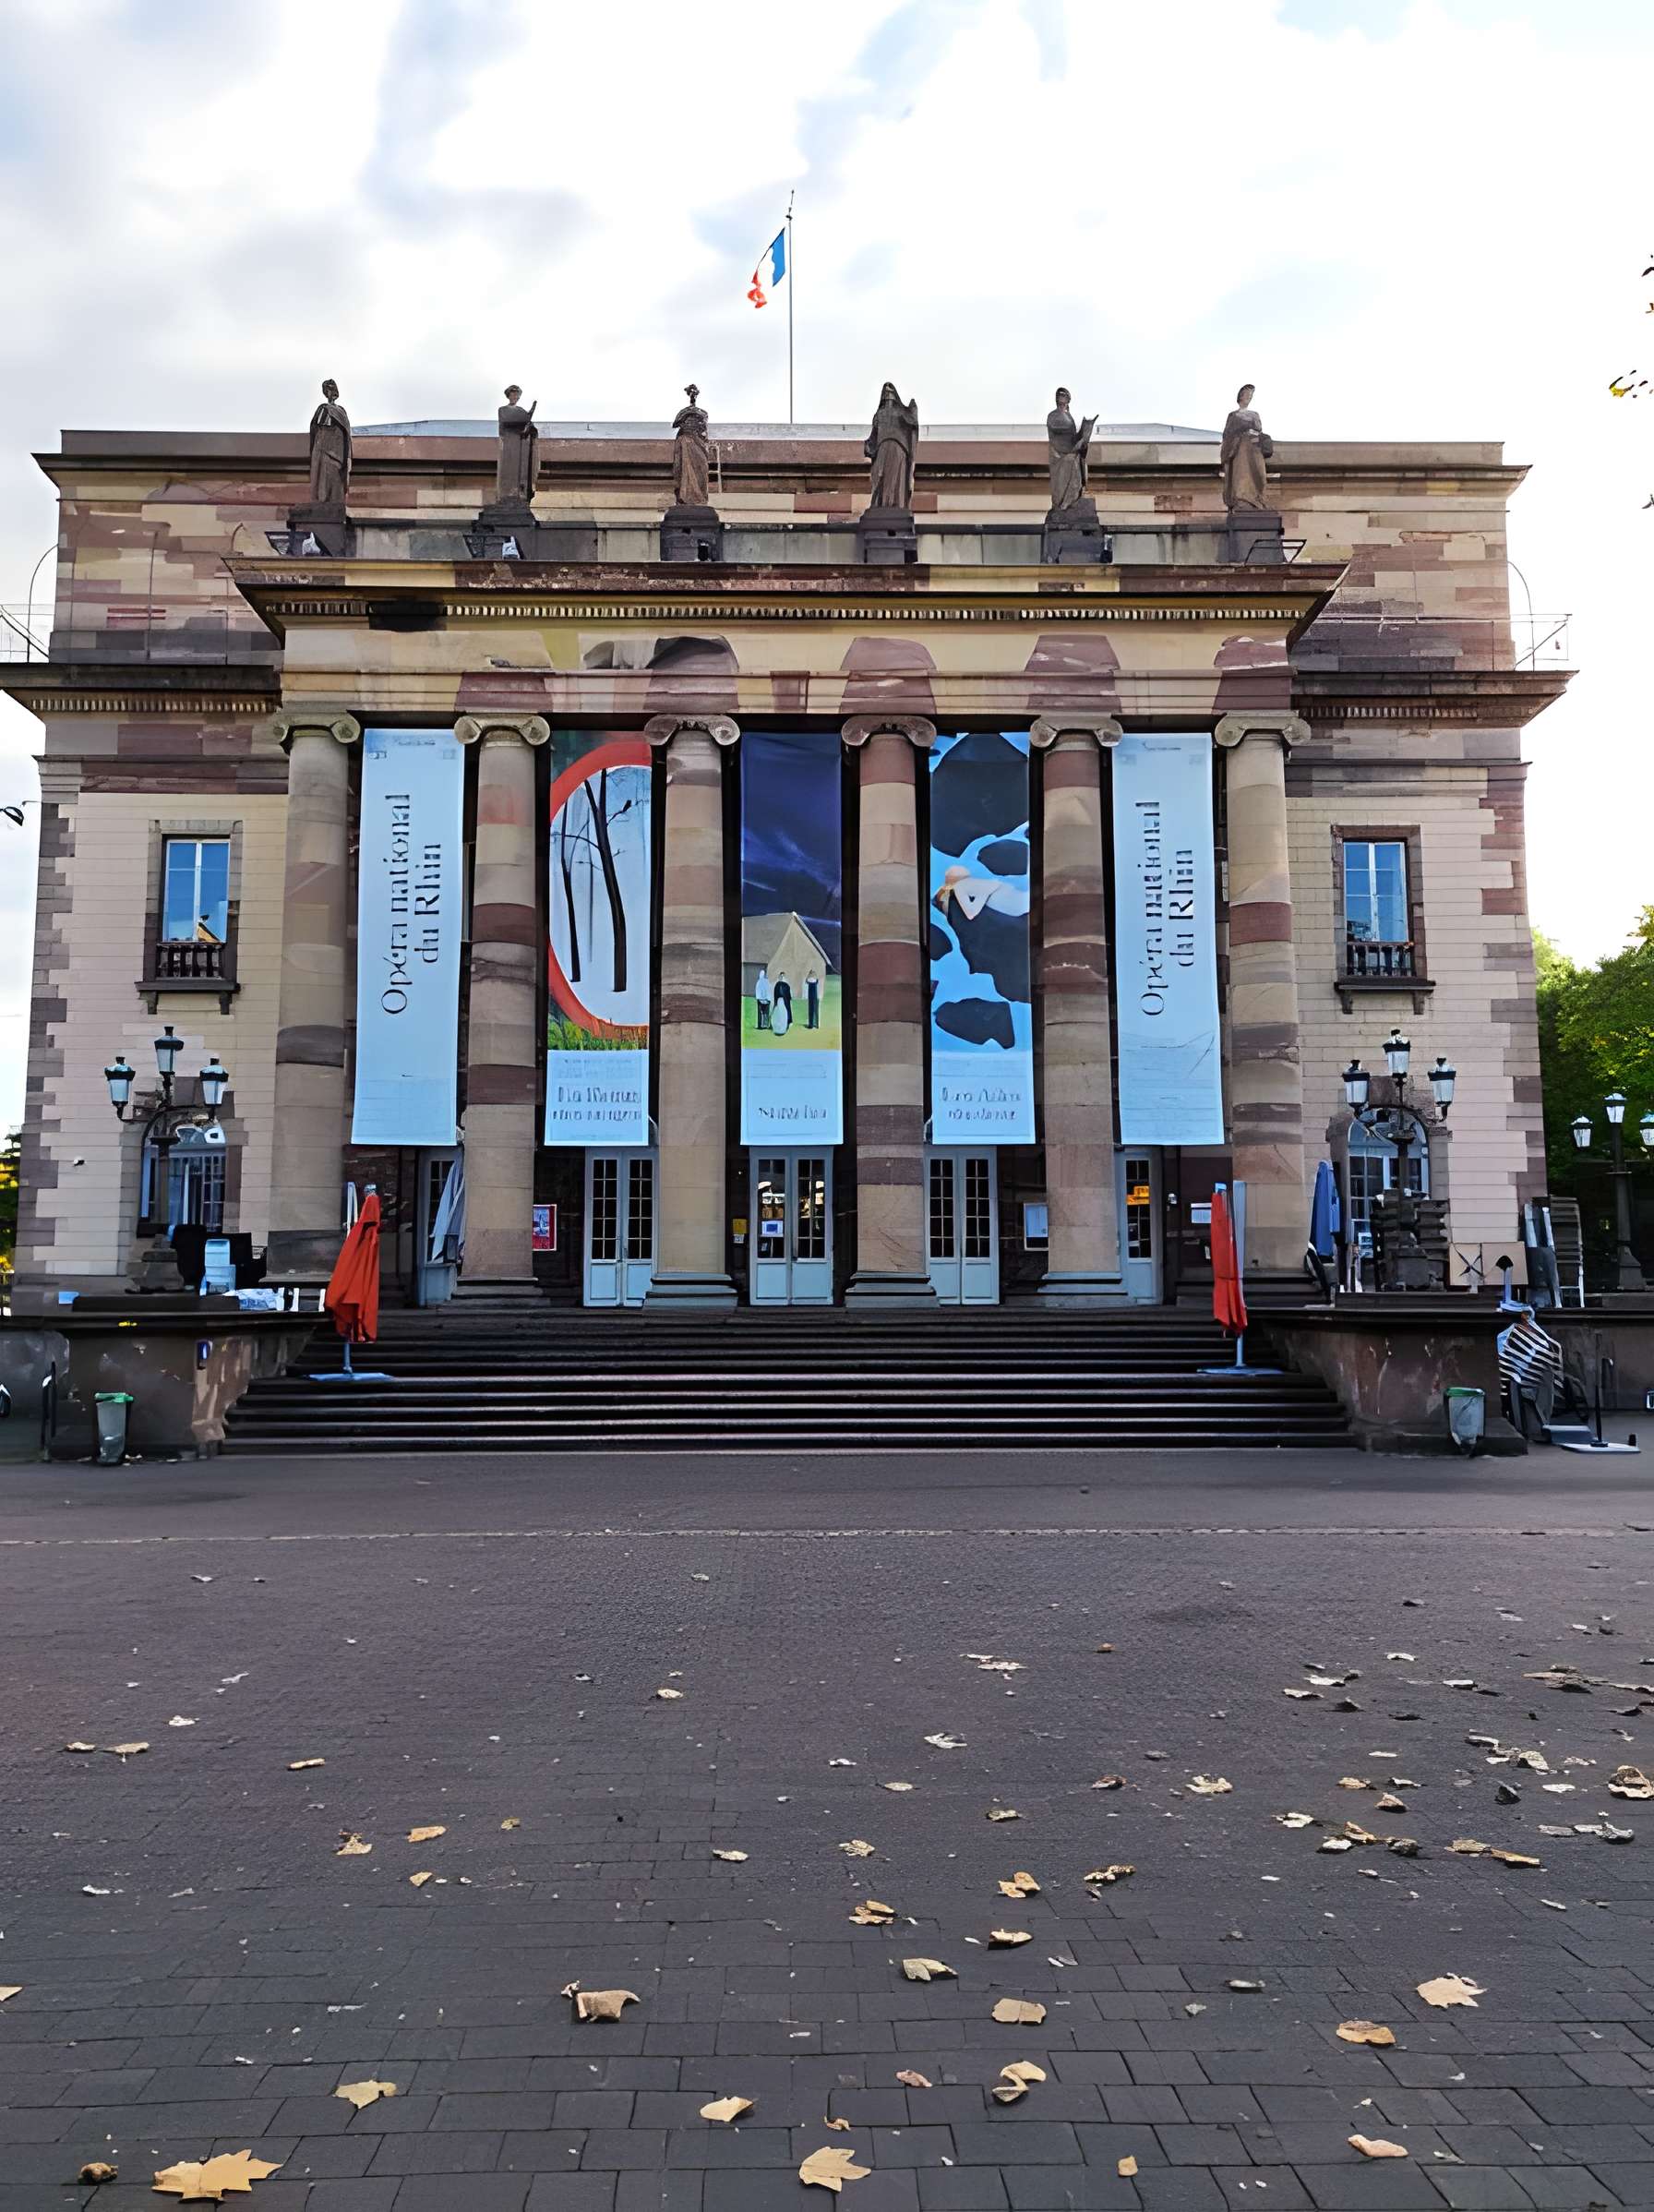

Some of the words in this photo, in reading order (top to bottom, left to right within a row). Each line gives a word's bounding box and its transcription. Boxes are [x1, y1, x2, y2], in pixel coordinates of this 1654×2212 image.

[383, 794, 411, 913] national
[414, 843, 441, 916] Rhin
[380, 923, 414, 1015] Opéra
[414, 928, 439, 964] du
